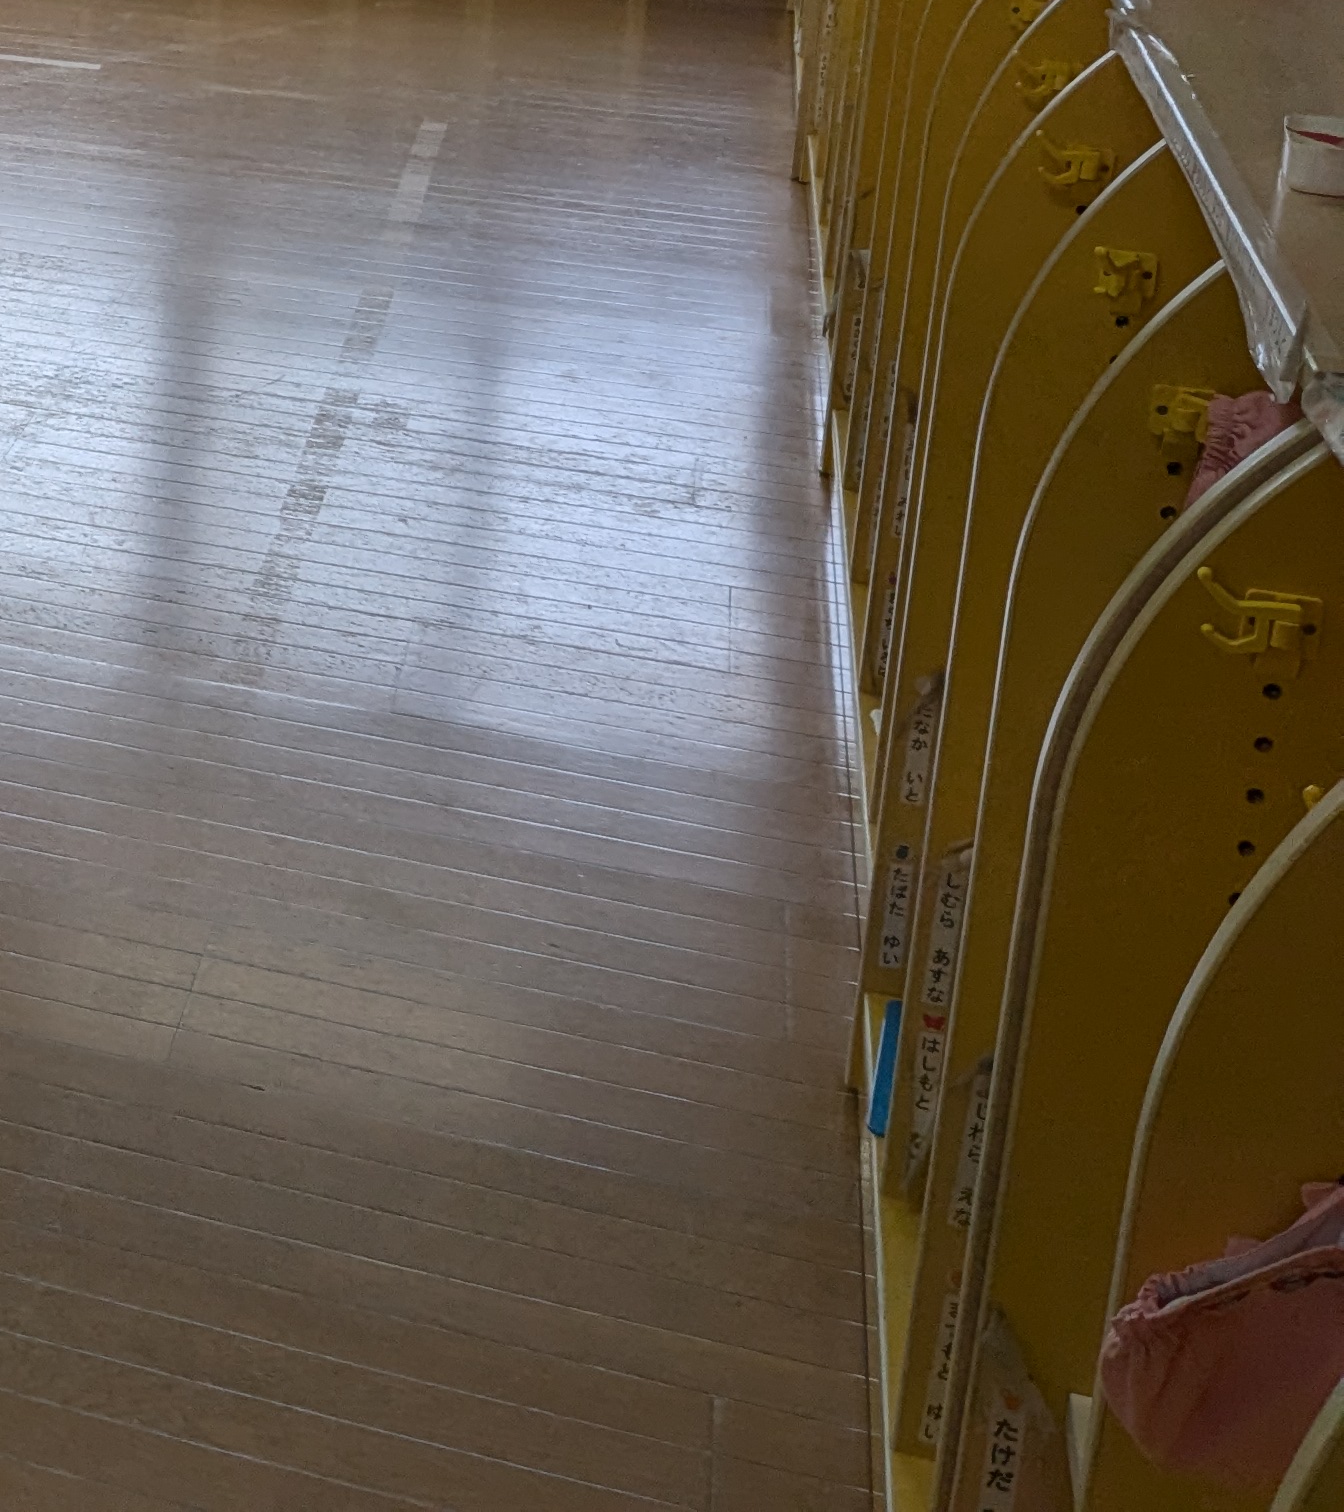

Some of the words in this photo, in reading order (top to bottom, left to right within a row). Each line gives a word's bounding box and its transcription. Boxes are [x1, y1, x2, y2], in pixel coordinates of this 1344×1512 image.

[939, 872, 960, 928] しむら
[883, 935, 900, 964] ゆい
[915, 1037, 940, 1110] はしもと
[987, 1419, 1019, 1492] たけだ
